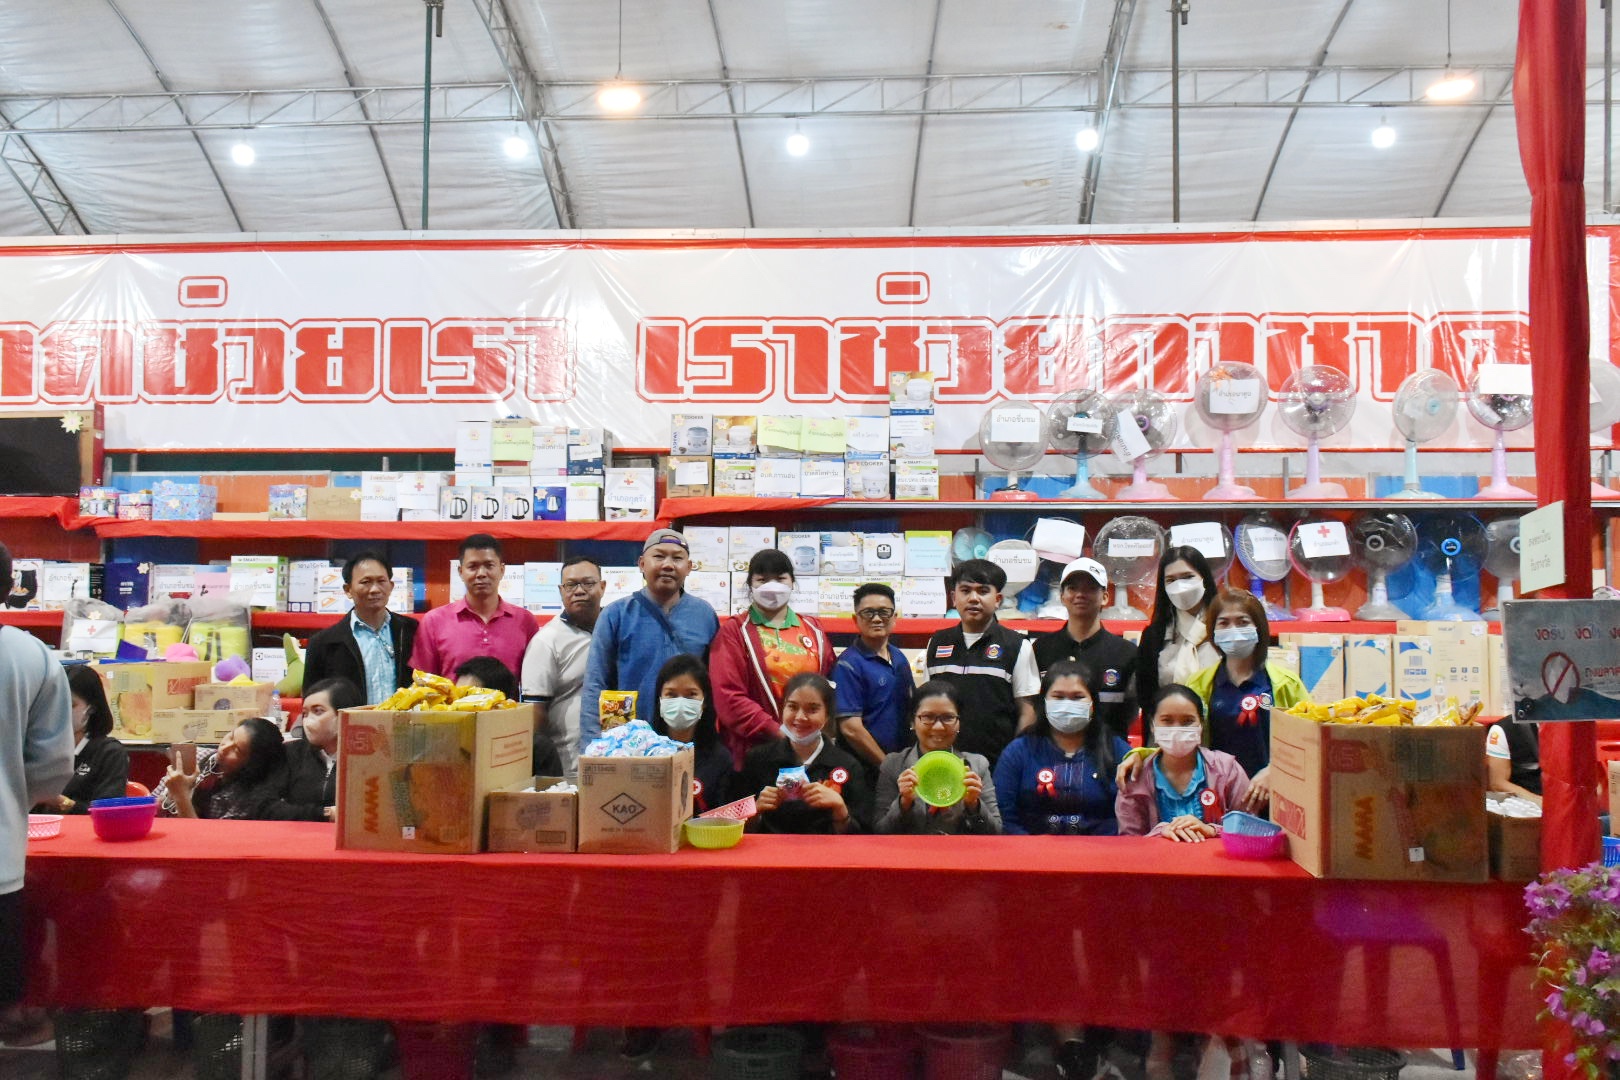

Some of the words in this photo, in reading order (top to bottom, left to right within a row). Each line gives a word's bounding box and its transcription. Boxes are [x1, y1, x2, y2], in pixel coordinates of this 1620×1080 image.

[995, 413, 1036, 423] อำเภอชื่นชม
[612, 803, 637, 815] KAO
